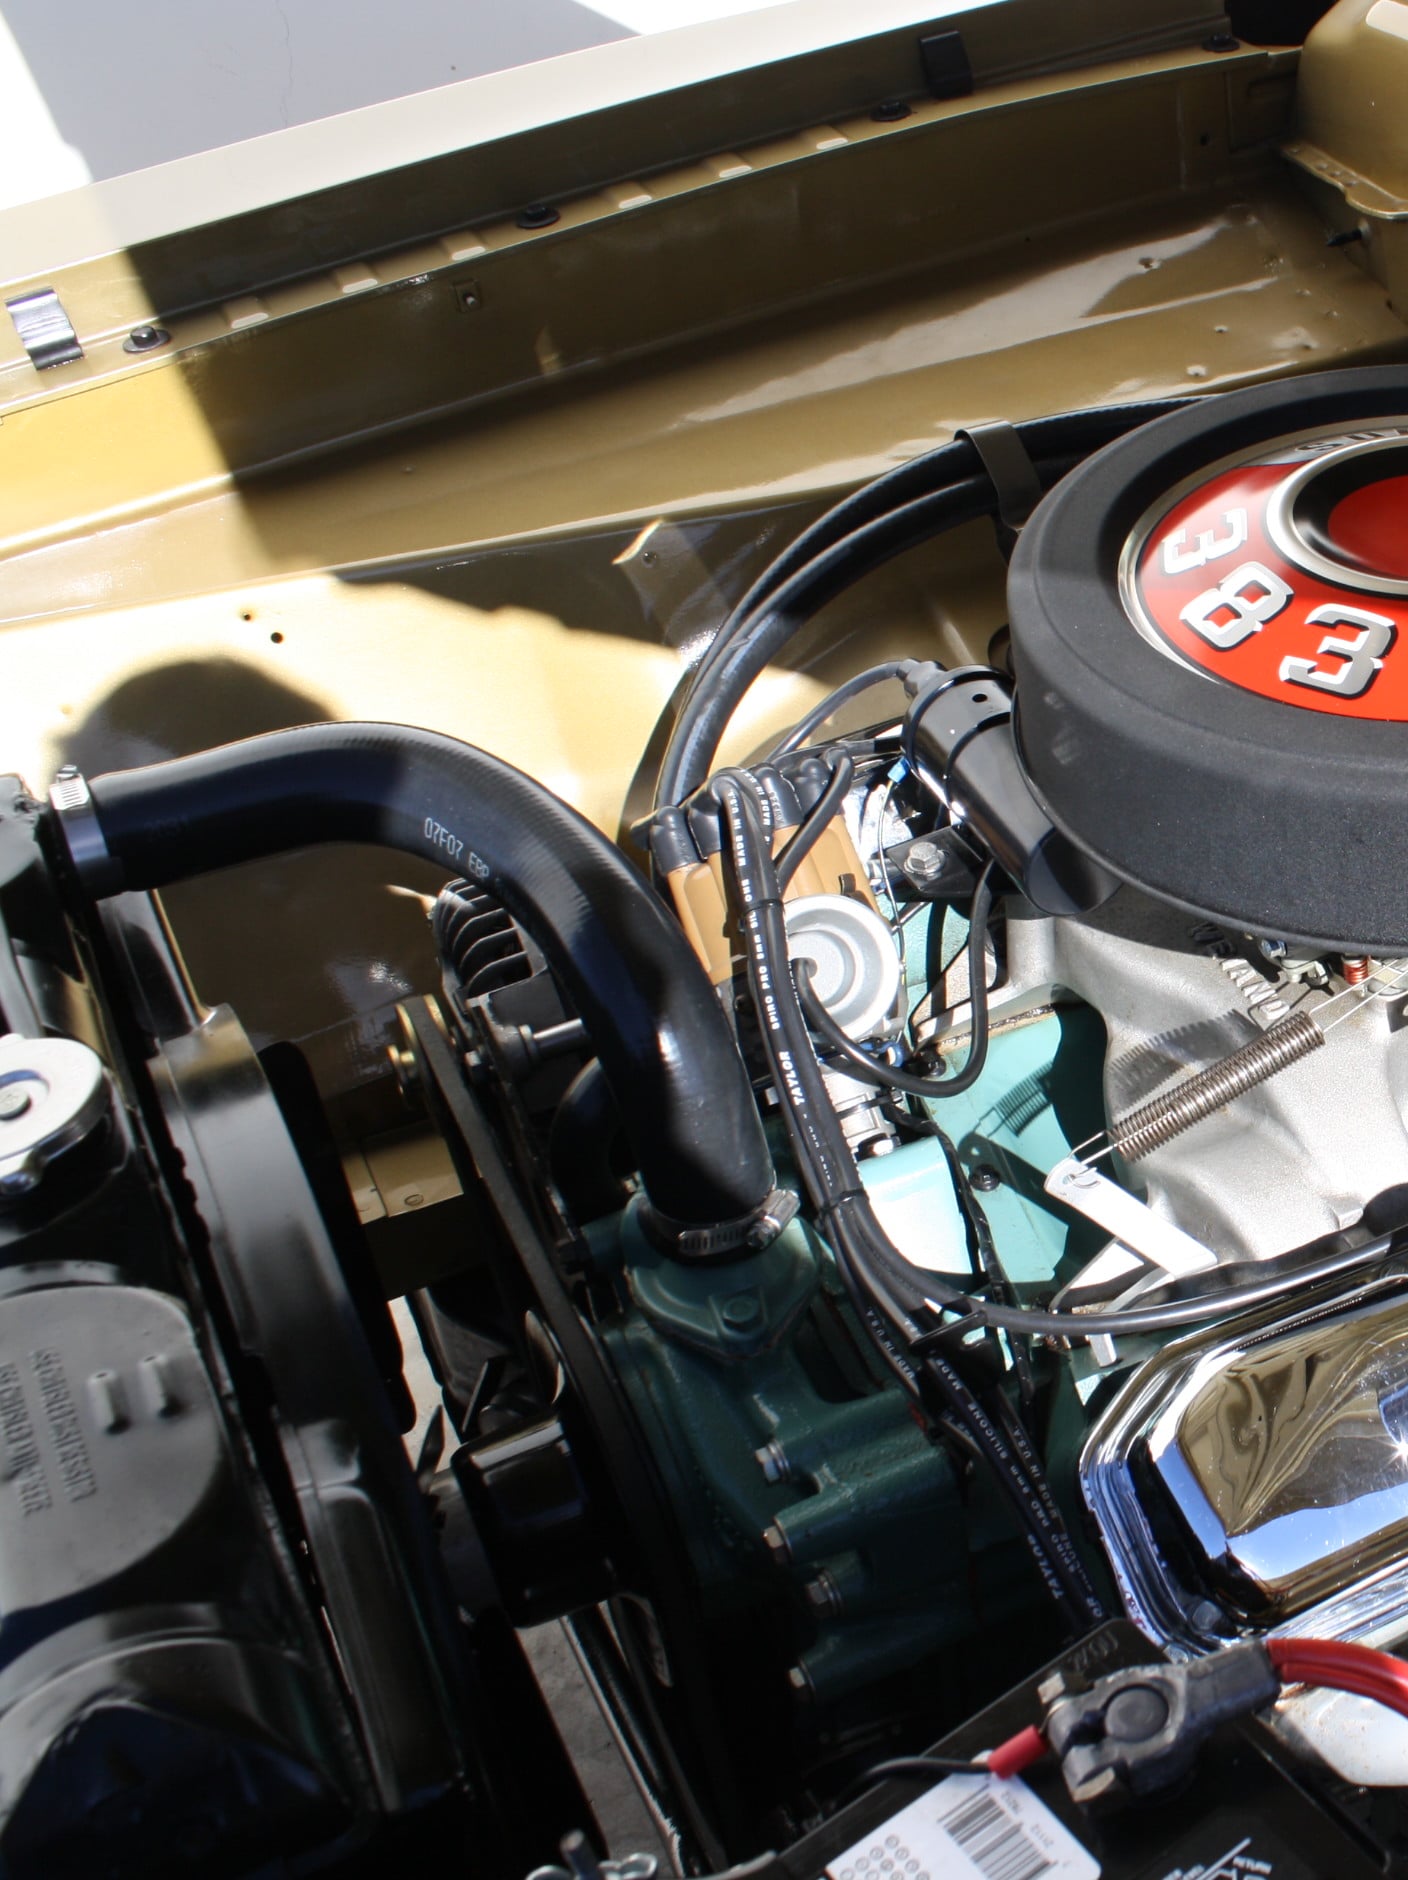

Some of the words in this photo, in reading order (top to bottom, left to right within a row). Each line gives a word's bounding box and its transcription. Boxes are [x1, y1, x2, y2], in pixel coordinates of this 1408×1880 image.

[1160, 508, 1399, 700] 383
[733, 819, 742, 830] IN
[735, 835, 746, 867] MADE
[758, 965, 770, 990] PRO
[764, 995, 781, 1030] SPIRO
[779, 1051, 805, 1106] TAYLOR
[967, 1402, 1009, 1460] SILICONE
